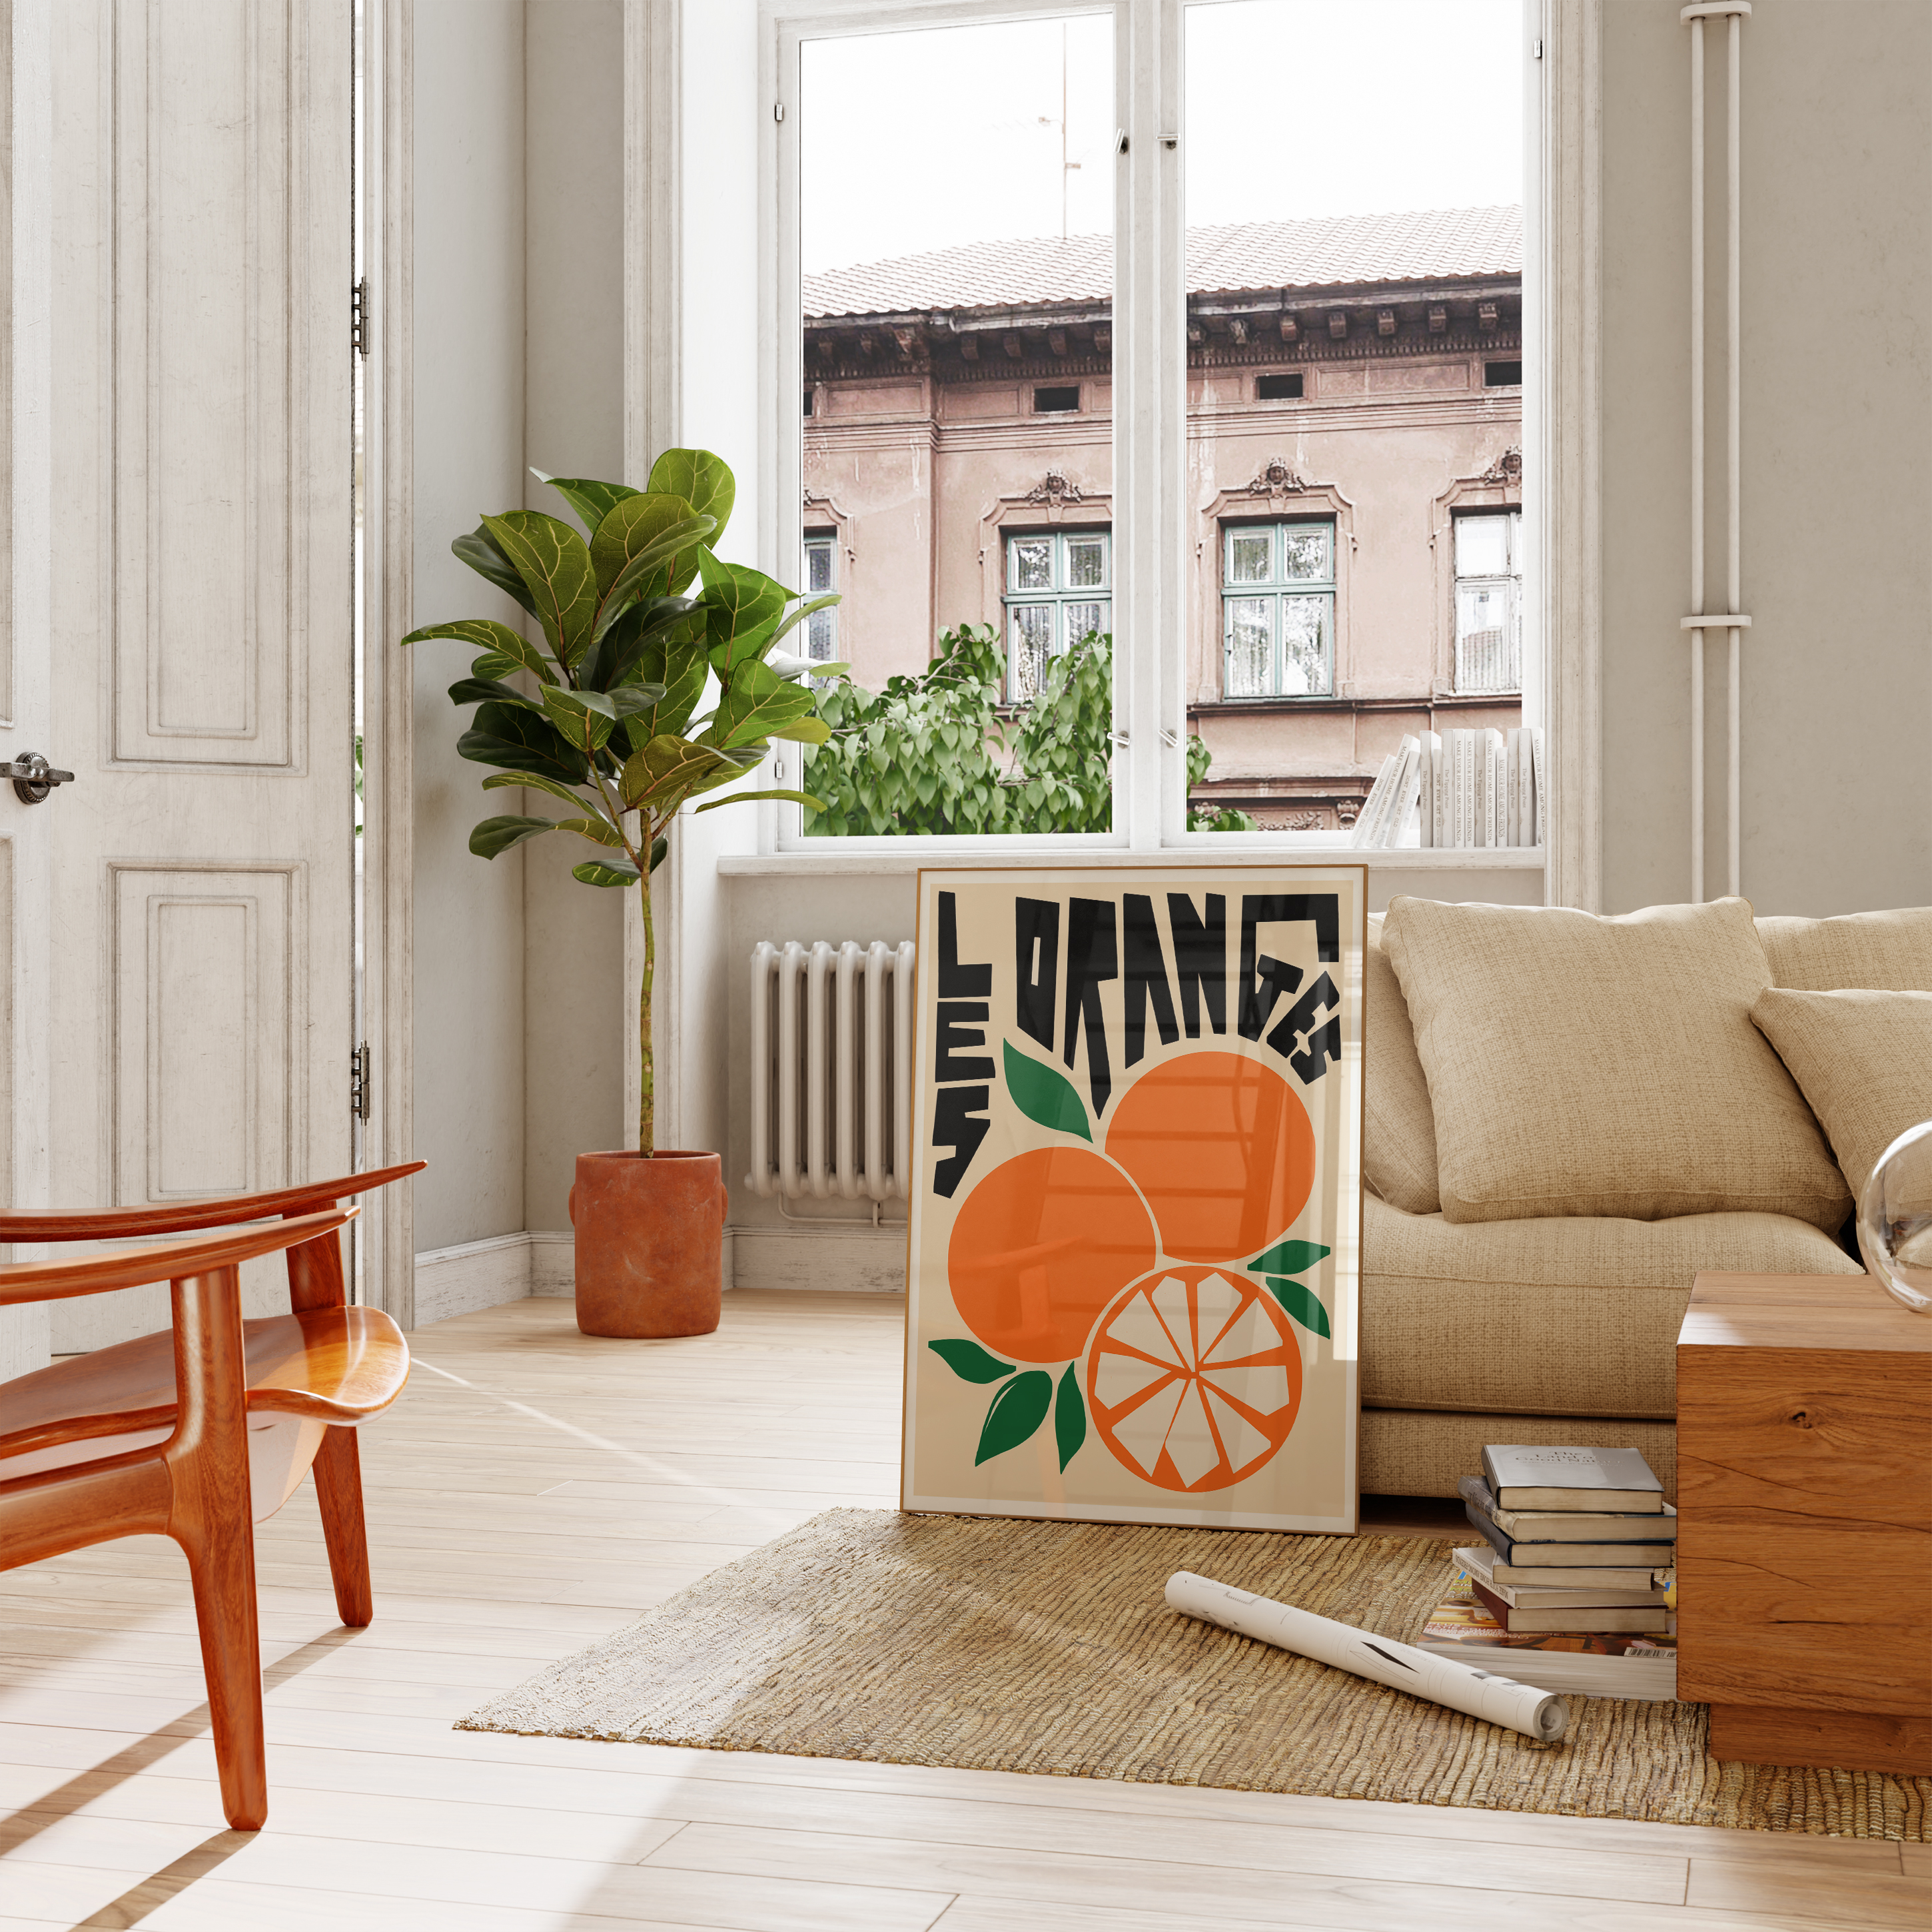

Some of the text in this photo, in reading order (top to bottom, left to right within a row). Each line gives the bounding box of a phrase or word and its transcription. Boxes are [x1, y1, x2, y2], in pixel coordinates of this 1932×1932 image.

[1397, 746, 1407, 763] MAKE
[1386, 778, 1395, 794] HOME
[1378, 794, 1388, 817] AMONG
[1369, 817, 1381, 841] FRIENDS
[1015, 893, 1341, 1121] ORANGES
[933, 891, 996, 1199] LES
